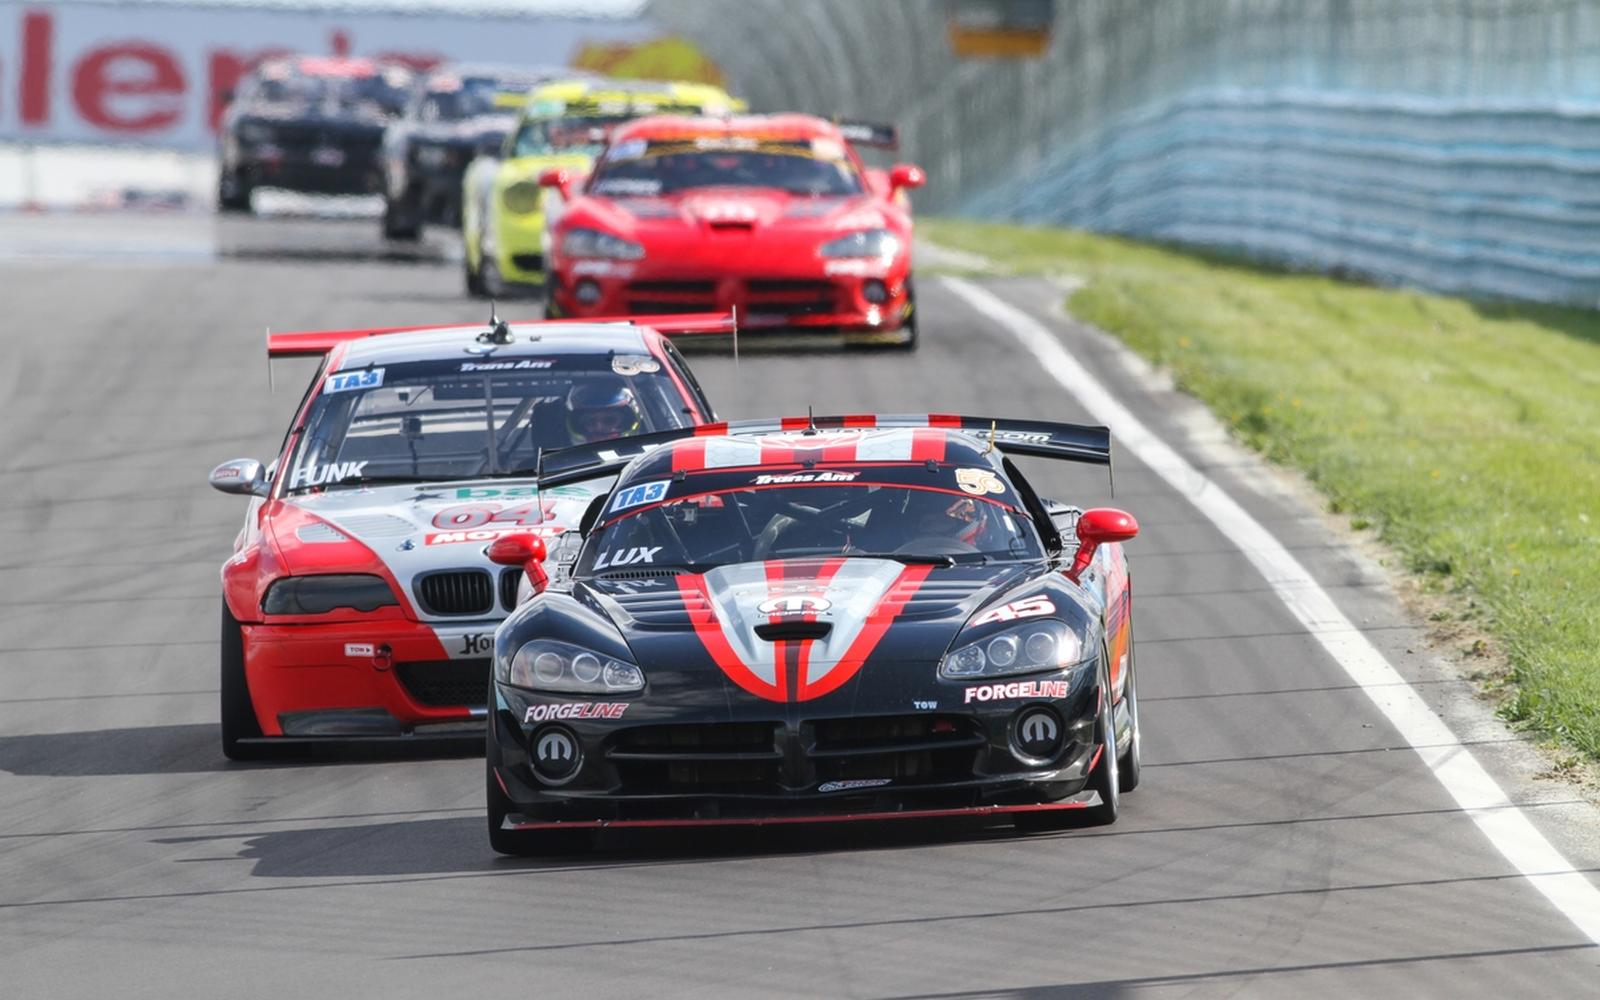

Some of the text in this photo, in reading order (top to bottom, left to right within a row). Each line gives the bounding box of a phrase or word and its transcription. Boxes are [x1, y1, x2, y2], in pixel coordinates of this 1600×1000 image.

[460, 359, 554, 372] Trans Am
[333, 371, 378, 390] TA3
[289, 461, 368, 489] FUNK
[755, 471, 856, 485] Trans Am
[618, 483, 665, 508] TA3
[592, 546, 663, 571] LUX
[969, 594, 1057, 628] 45
[963, 680, 1069, 704] FORGELINE
[523, 702, 630, 723] FORGELINE
[914, 701, 938, 710] TOW
